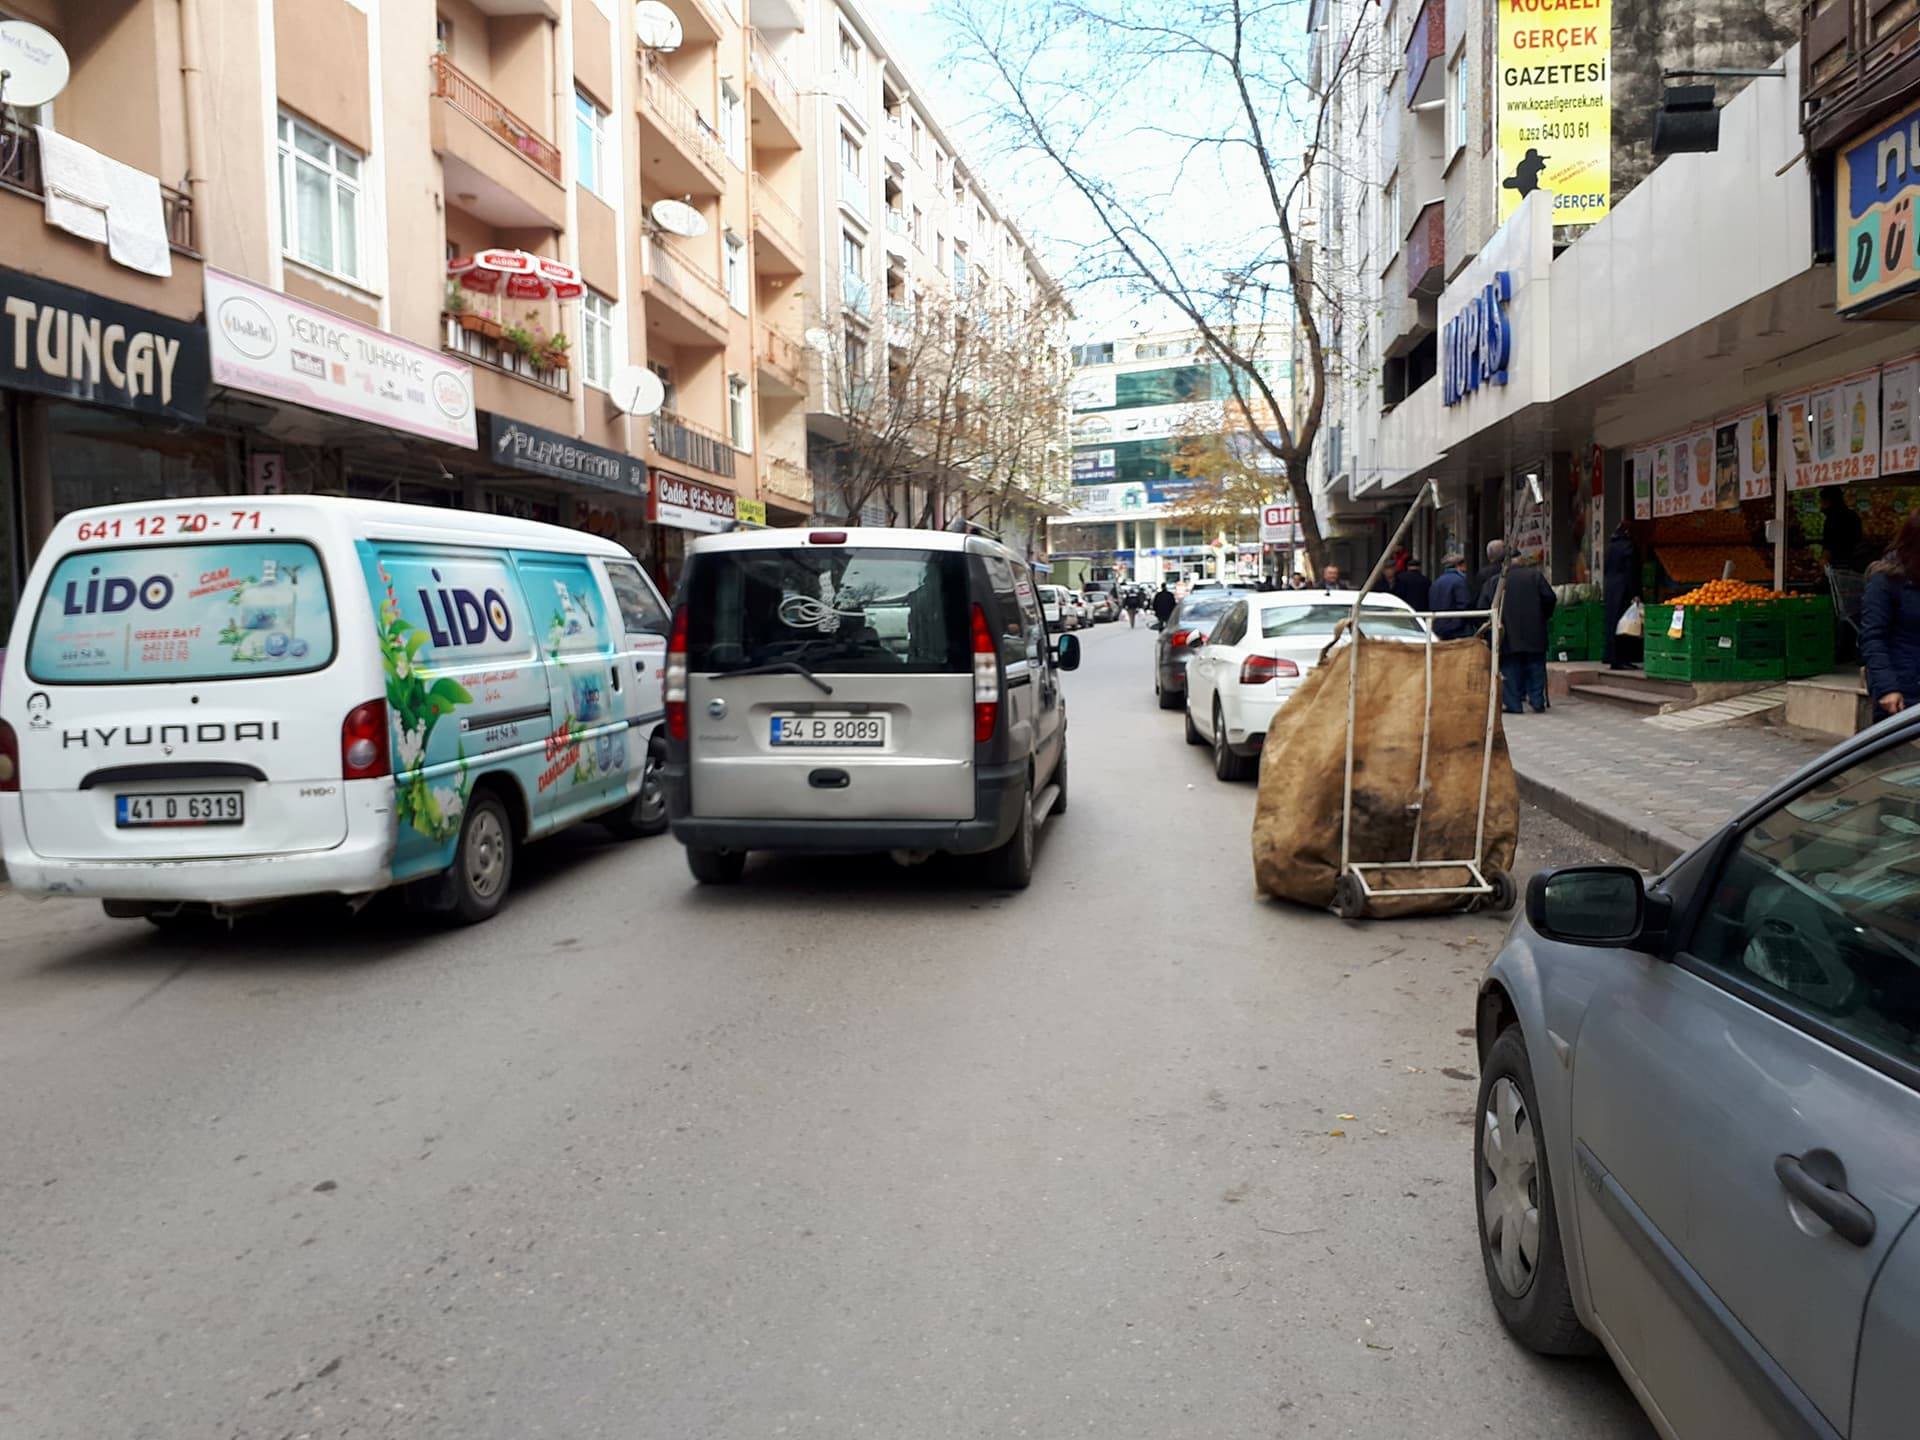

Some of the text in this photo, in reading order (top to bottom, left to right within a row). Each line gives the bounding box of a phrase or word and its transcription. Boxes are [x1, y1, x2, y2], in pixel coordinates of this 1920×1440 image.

[1513, 26, 1598, 53] GERÇEK
[1504, 57, 1606, 86] GAZETESİ
[1506, 95, 1604, 112] www.kocaeligercek.net
[1542, 123, 1561, 140] 643
[1563, 122, 1575, 139] 03
[1578, 121, 1590, 138] 61
[1553, 193, 1606, 212] GERÇEK
[1852, 198, 1920, 283] DÜ
[5, 295, 181, 406] TUNCAY
[287, 313, 350, 361] SERTAÇ
[661, 478, 689, 505] Cadde
[78, 520, 122, 541] 641
[135, 516, 166, 535] 12
[231, 511, 261, 529] 71
[63, 566, 174, 615] LİDO
[199, 567, 231, 585] CAM
[418, 567, 513, 648] LİDO
[62, 720, 280, 749] HYUNDAI
[544, 720, 569, 763] CAM
[782, 720, 879, 740] 54 B 8089
[131, 796, 239, 819] 41 D 6319
